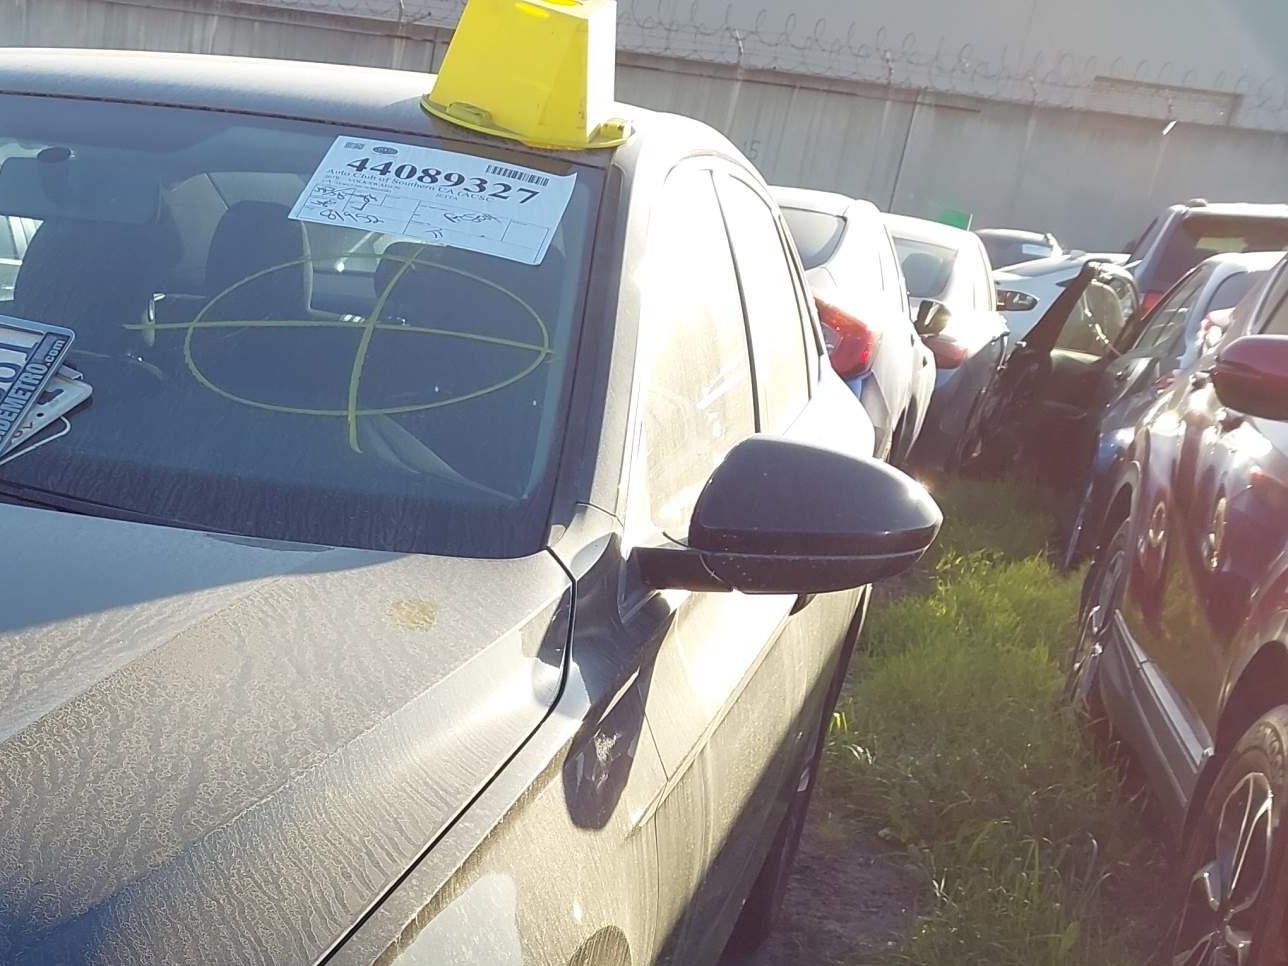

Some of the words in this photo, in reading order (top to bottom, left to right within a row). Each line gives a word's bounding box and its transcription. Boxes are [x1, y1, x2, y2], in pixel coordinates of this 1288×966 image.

[327, 168, 351, 177] Auto
[353, 172, 377, 180] Club
[378, 175, 390, 183] of
[393, 178, 435, 191] Southern
[346, 157, 540, 204] 44089327
